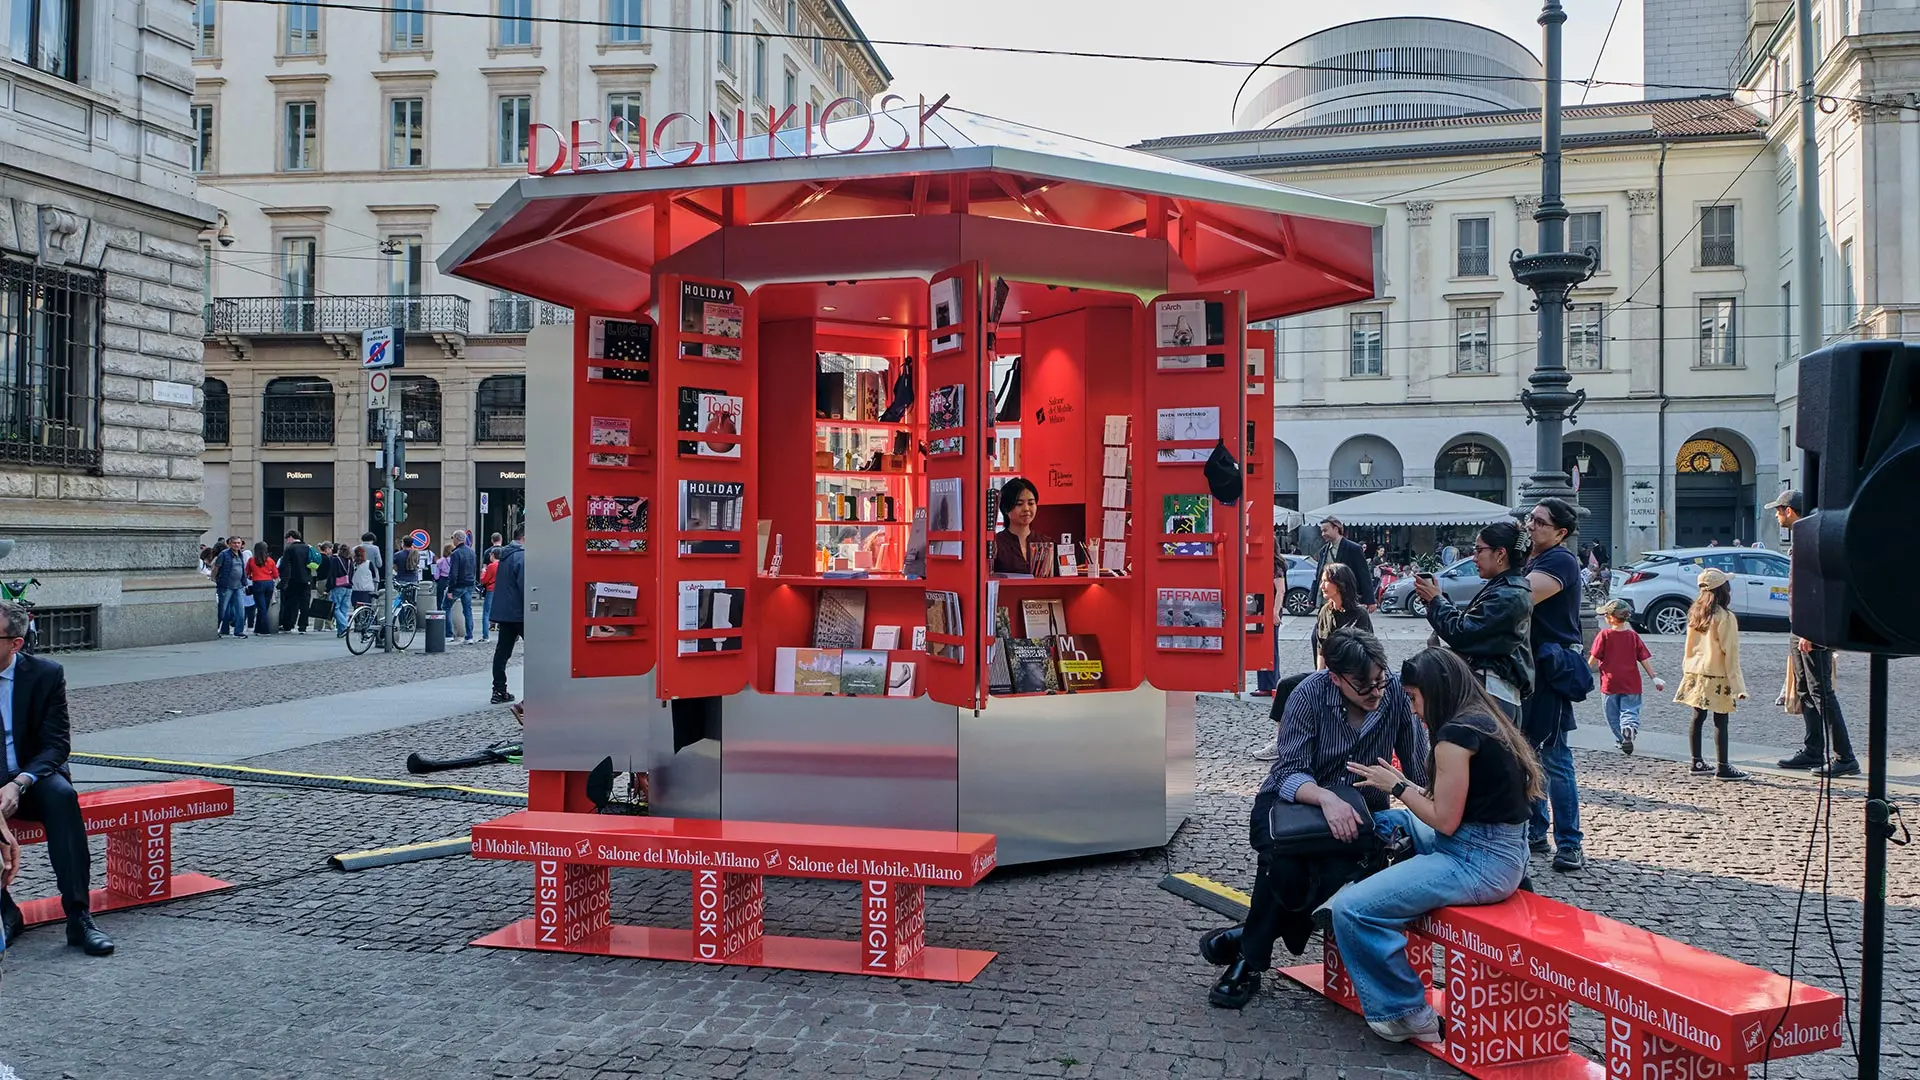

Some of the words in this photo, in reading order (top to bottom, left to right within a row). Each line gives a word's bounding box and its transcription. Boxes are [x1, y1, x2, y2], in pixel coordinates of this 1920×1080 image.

[528, 109, 744, 176] DESIGN
[768, 93, 951, 158] KIOSK
[684, 284, 732, 300] HOLIDAY
[607, 325, 649, 338] LUCE
[704, 396, 741, 415] Tools
[690, 483, 742, 495] HOLIDAY
[931, 480, 956, 493] HOLIDAY
[1333, 478, 1396, 489] RISTORANTE
[603, 586, 631, 595] Openhouse
[142, 802, 228, 823] Mobile.Milano
[148, 824, 164, 897] DESIGN
[485, 838, 572, 858] Mobile.Milano
[597, 845, 640, 862] Salone
[643, 848, 664, 864] del
[666, 849, 760, 869] Mobile.Milano
[788, 856, 834, 873] Salone
[837, 859, 858, 875] del
[862, 860, 962, 881] Mobile.Milano
[564, 870, 605, 903] DESIGN
[723, 878, 758, 913] DESIGN
[540, 861, 557, 943] DESIGN
[580, 888, 611, 917] KIOSK
[700, 870, 717, 938] KIOSK
[736, 897, 763, 927] KIOSK
[895, 887, 921, 925] DESIGN
[869, 880, 887, 968] DESIGN
[700, 943, 716, 959] D
[1451, 948, 1466, 1039] KIOSK
[1529, 956, 1576, 992] Salone
[1578, 976, 1601, 1003] del
[1604, 986, 1721, 1051] Mobile.Milano
[1503, 1003, 1569, 1032] KIOSK
[1773, 1023, 1830, 1049] Salone
[1451, 1042, 1466, 1064] D
